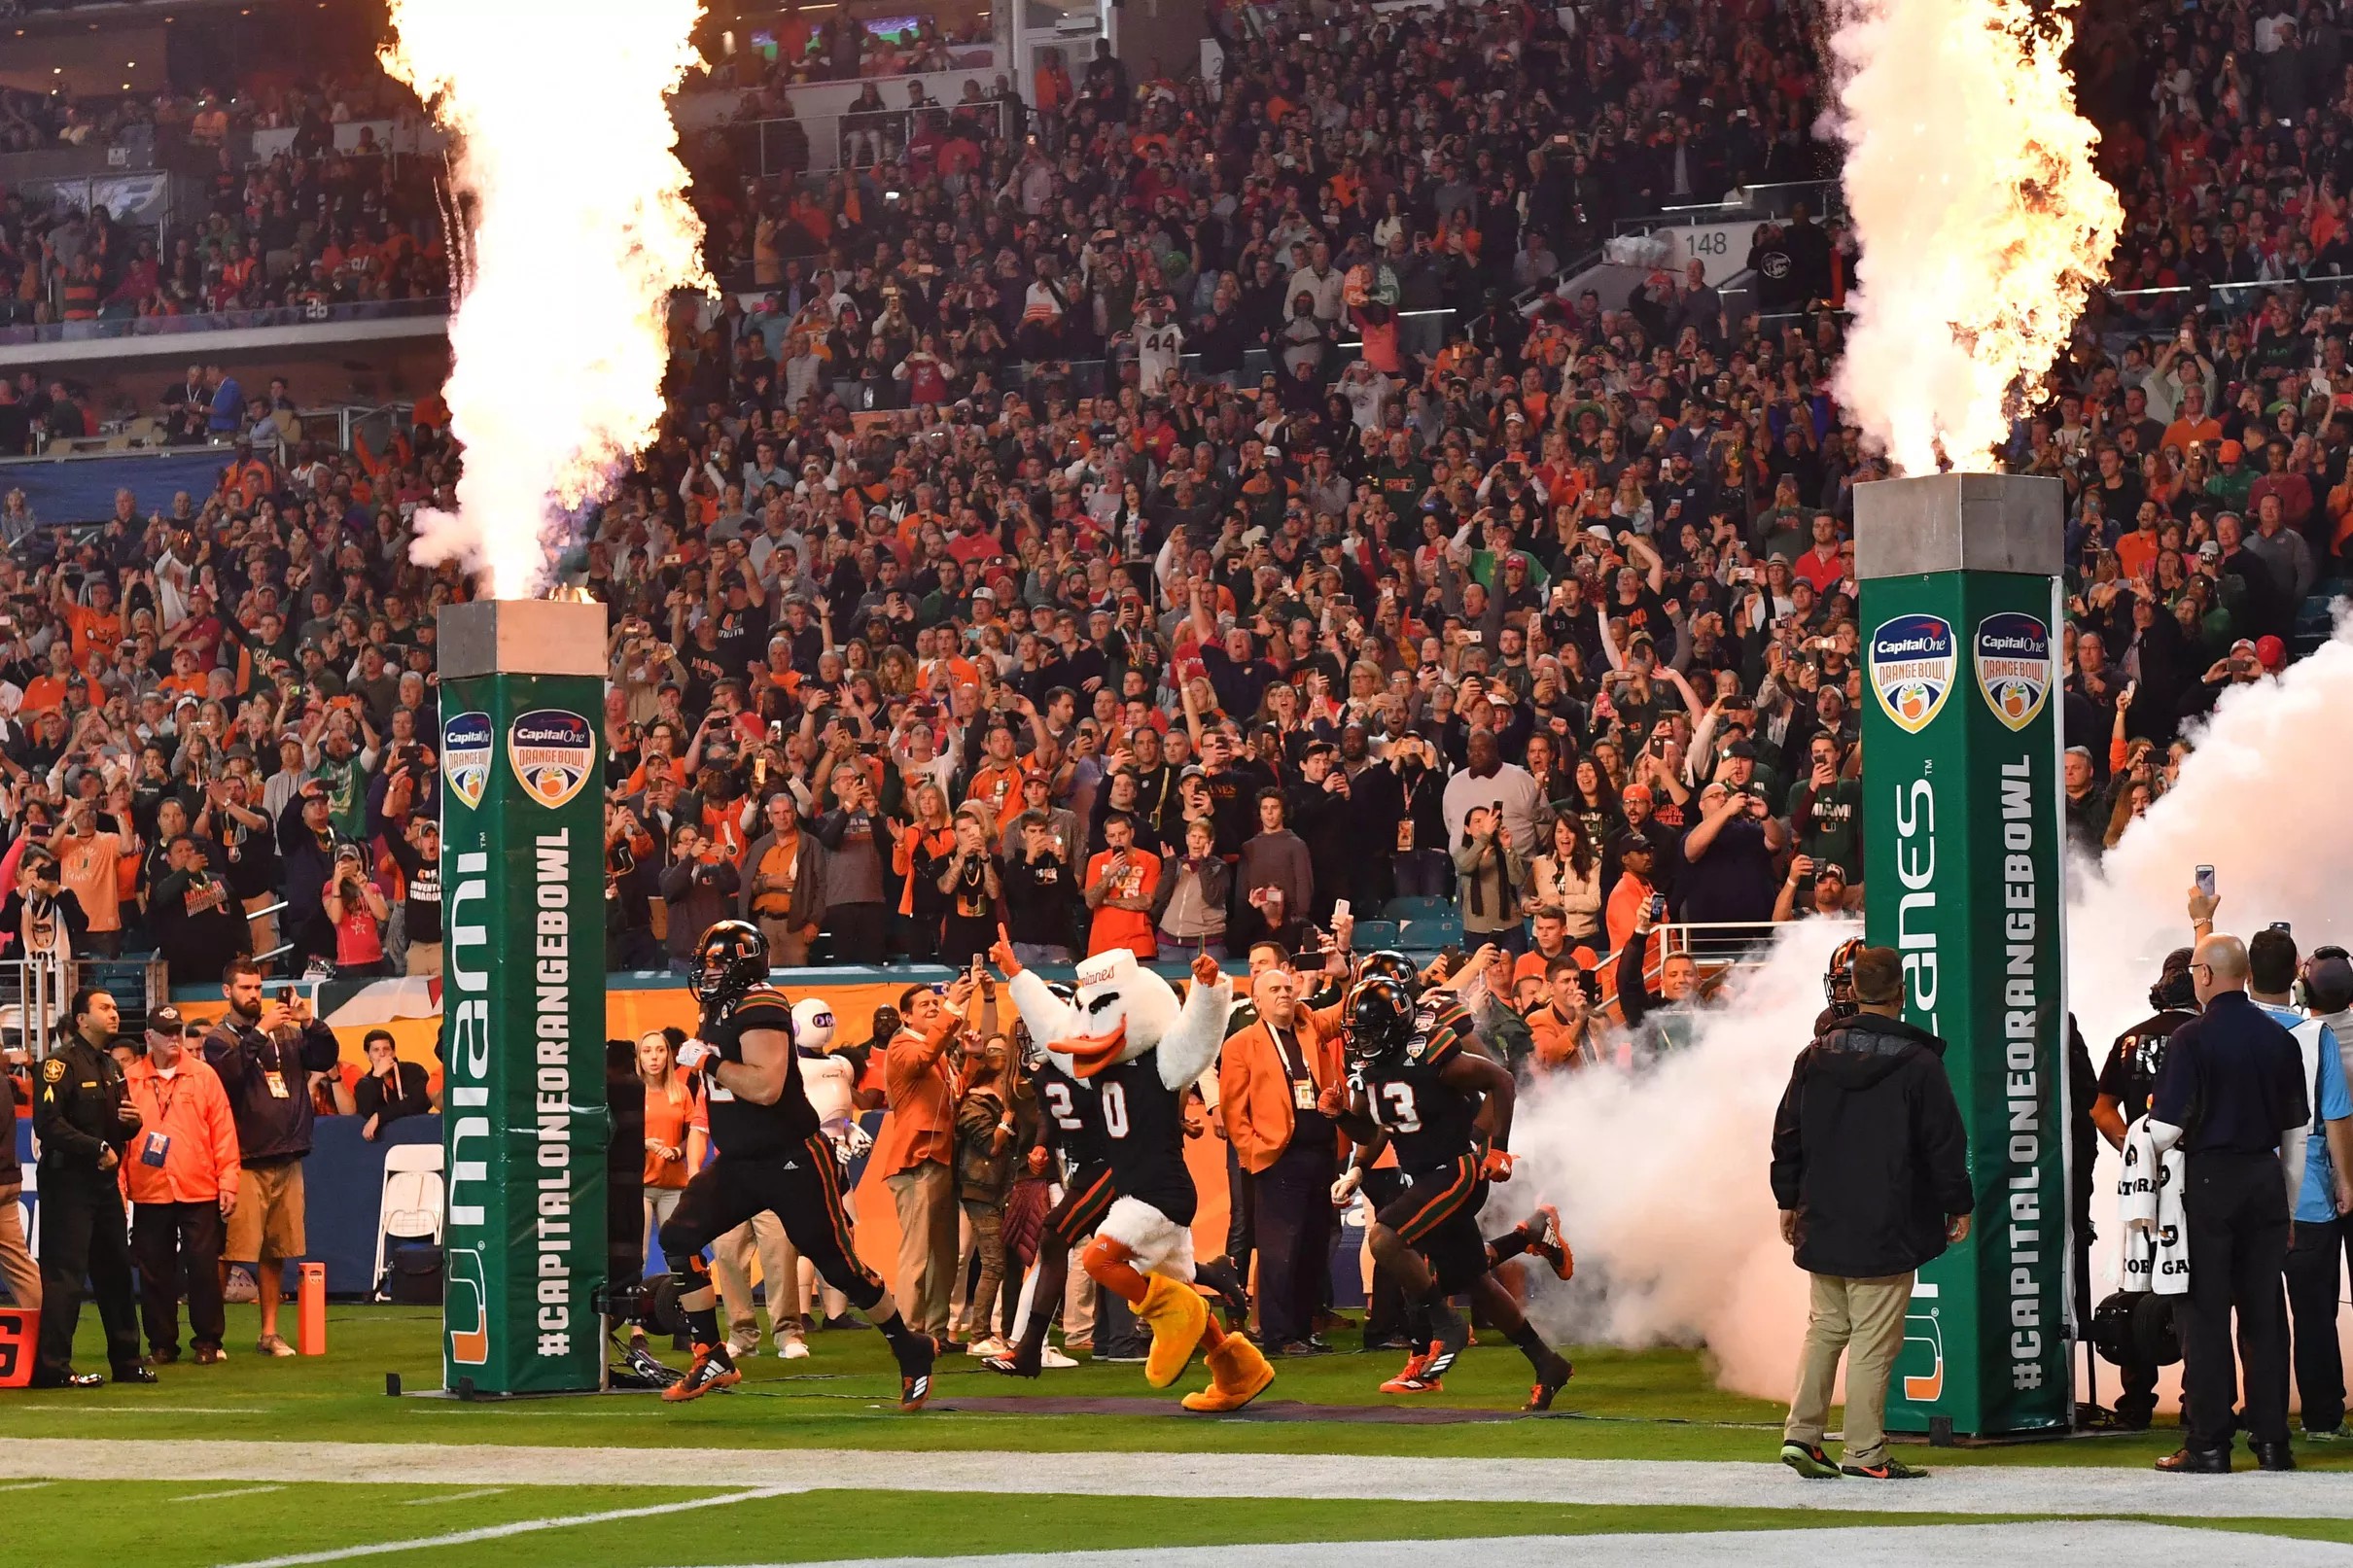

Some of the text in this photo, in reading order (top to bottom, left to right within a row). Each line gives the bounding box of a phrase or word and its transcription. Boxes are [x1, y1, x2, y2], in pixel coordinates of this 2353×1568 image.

[1686, 231, 1727, 256] 148
[305, 296, 329, 319] 26
[1145, 332, 1176, 353] 44
[1879, 660, 1947, 686] ORANGE BOWL
[1983, 659, 2045, 684] ORANGE BOWL
[518, 749, 585, 769] ORANGE BOWL
[1924, 758, 1933, 777] TM
[1811, 802, 1851, 818] MIAMI
[479, 832, 487, 849] TM
[735, 940, 761, 959] U
[1389, 964, 1414, 984] U
[1392, 993, 1411, 1016] U
[2000, 754, 2043, 1391] #CAPITALONEORANGEBOWL
[535, 826, 572, 1357] #CAPITALONEORANGEBOWL
[1102, 1081, 1130, 1139] 0
[1365, 1080, 1423, 1133] 13
